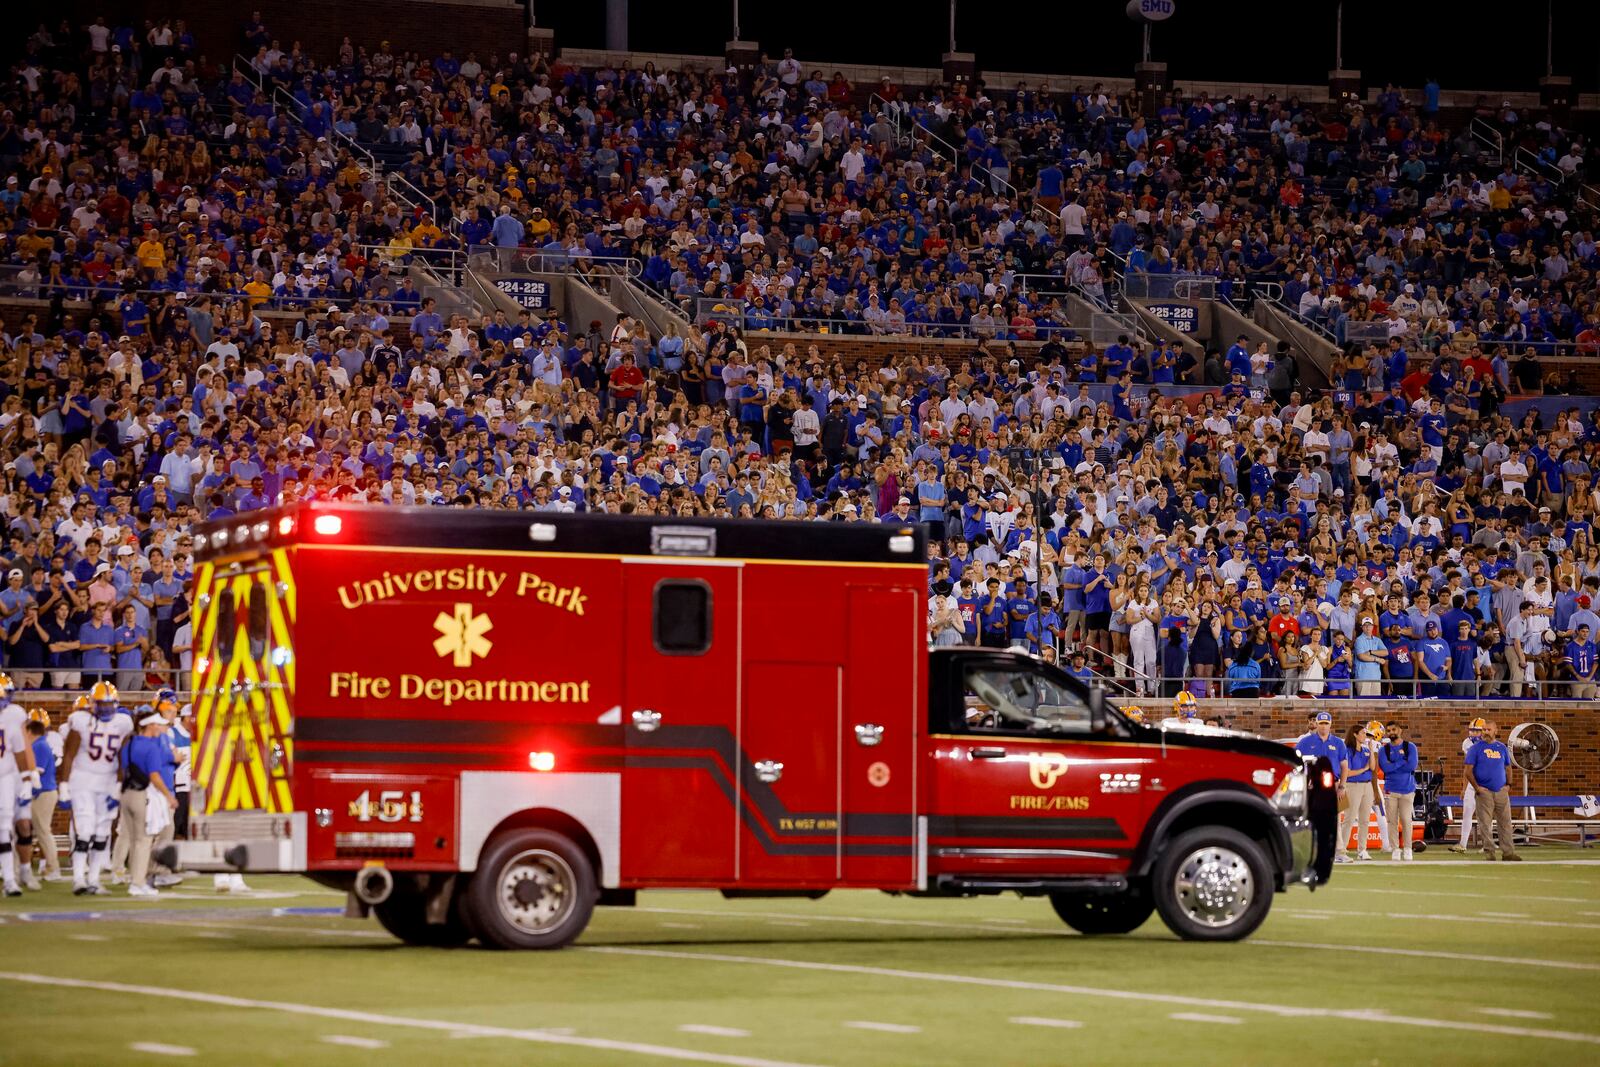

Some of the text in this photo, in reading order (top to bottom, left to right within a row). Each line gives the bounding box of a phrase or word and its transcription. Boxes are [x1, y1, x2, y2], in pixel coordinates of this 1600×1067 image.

[1142, 0, 1171, 13] SMU
[497, 281, 545, 294] 224-225
[1149, 307, 1194, 319] 225-226
[1338, 393, 1350, 401] 126
[337, 564, 589, 615] University Park
[1579, 657, 1589, 673] 11
[329, 671, 590, 706] Fire Department
[89, 733, 121, 763] 55
[354, 790, 422, 822] 451
[1010, 795, 1090, 810] FIRE/EMS
